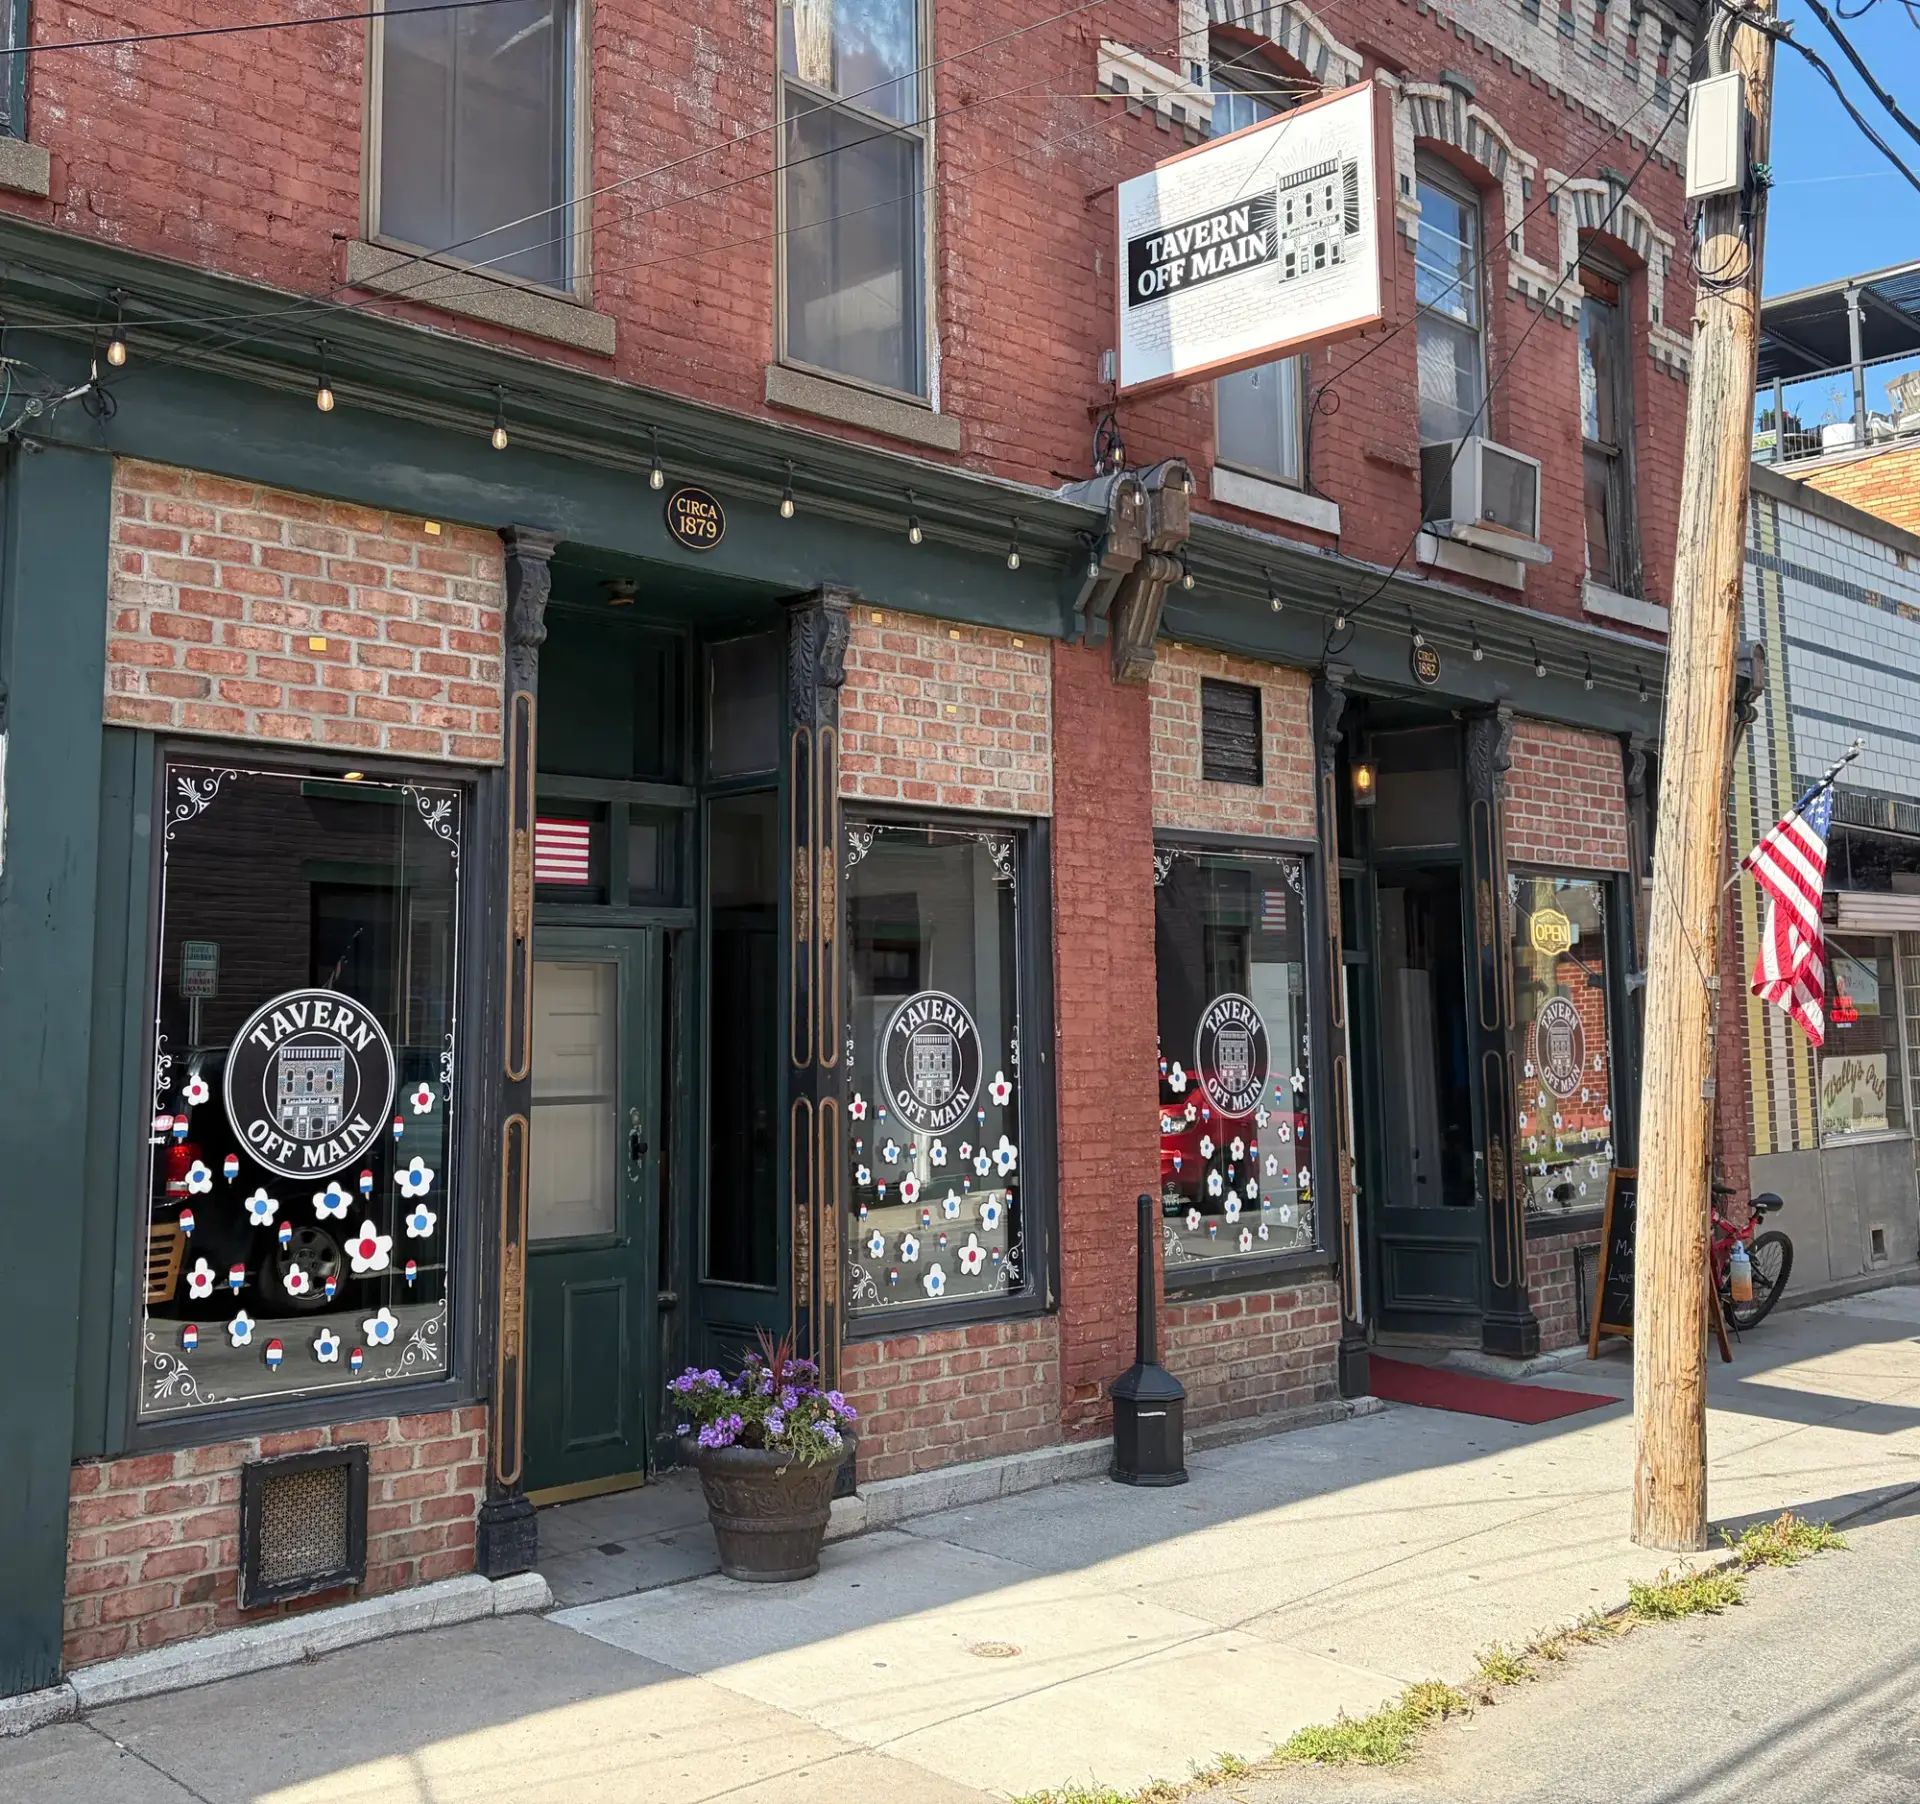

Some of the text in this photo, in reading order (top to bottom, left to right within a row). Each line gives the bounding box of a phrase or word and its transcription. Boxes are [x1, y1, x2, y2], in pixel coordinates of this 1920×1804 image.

[1145, 205, 1250, 265] TAVERN
[1137, 230, 1269, 296] OFF MAIN
[676, 497, 719, 520] CIRCA
[679, 515, 718, 539] 1879
[1535, 923, 1568, 942] OPEN
[249, 1000, 377, 1053] TAVERN
[895, 999, 971, 1040] TAVERN
[1205, 1000, 1261, 1036] TAVERN
[1540, 1003, 1578, 1032] TAVERN
[1207, 1076, 1262, 1111] OFF MAIN
[1543, 1063, 1581, 1093] OFF MAIN
[1824, 1058, 1885, 1108] Wally's Pub
[897, 1086, 971, 1128] OFF MAIN
[247, 1113, 373, 1168] OFF MAIN
